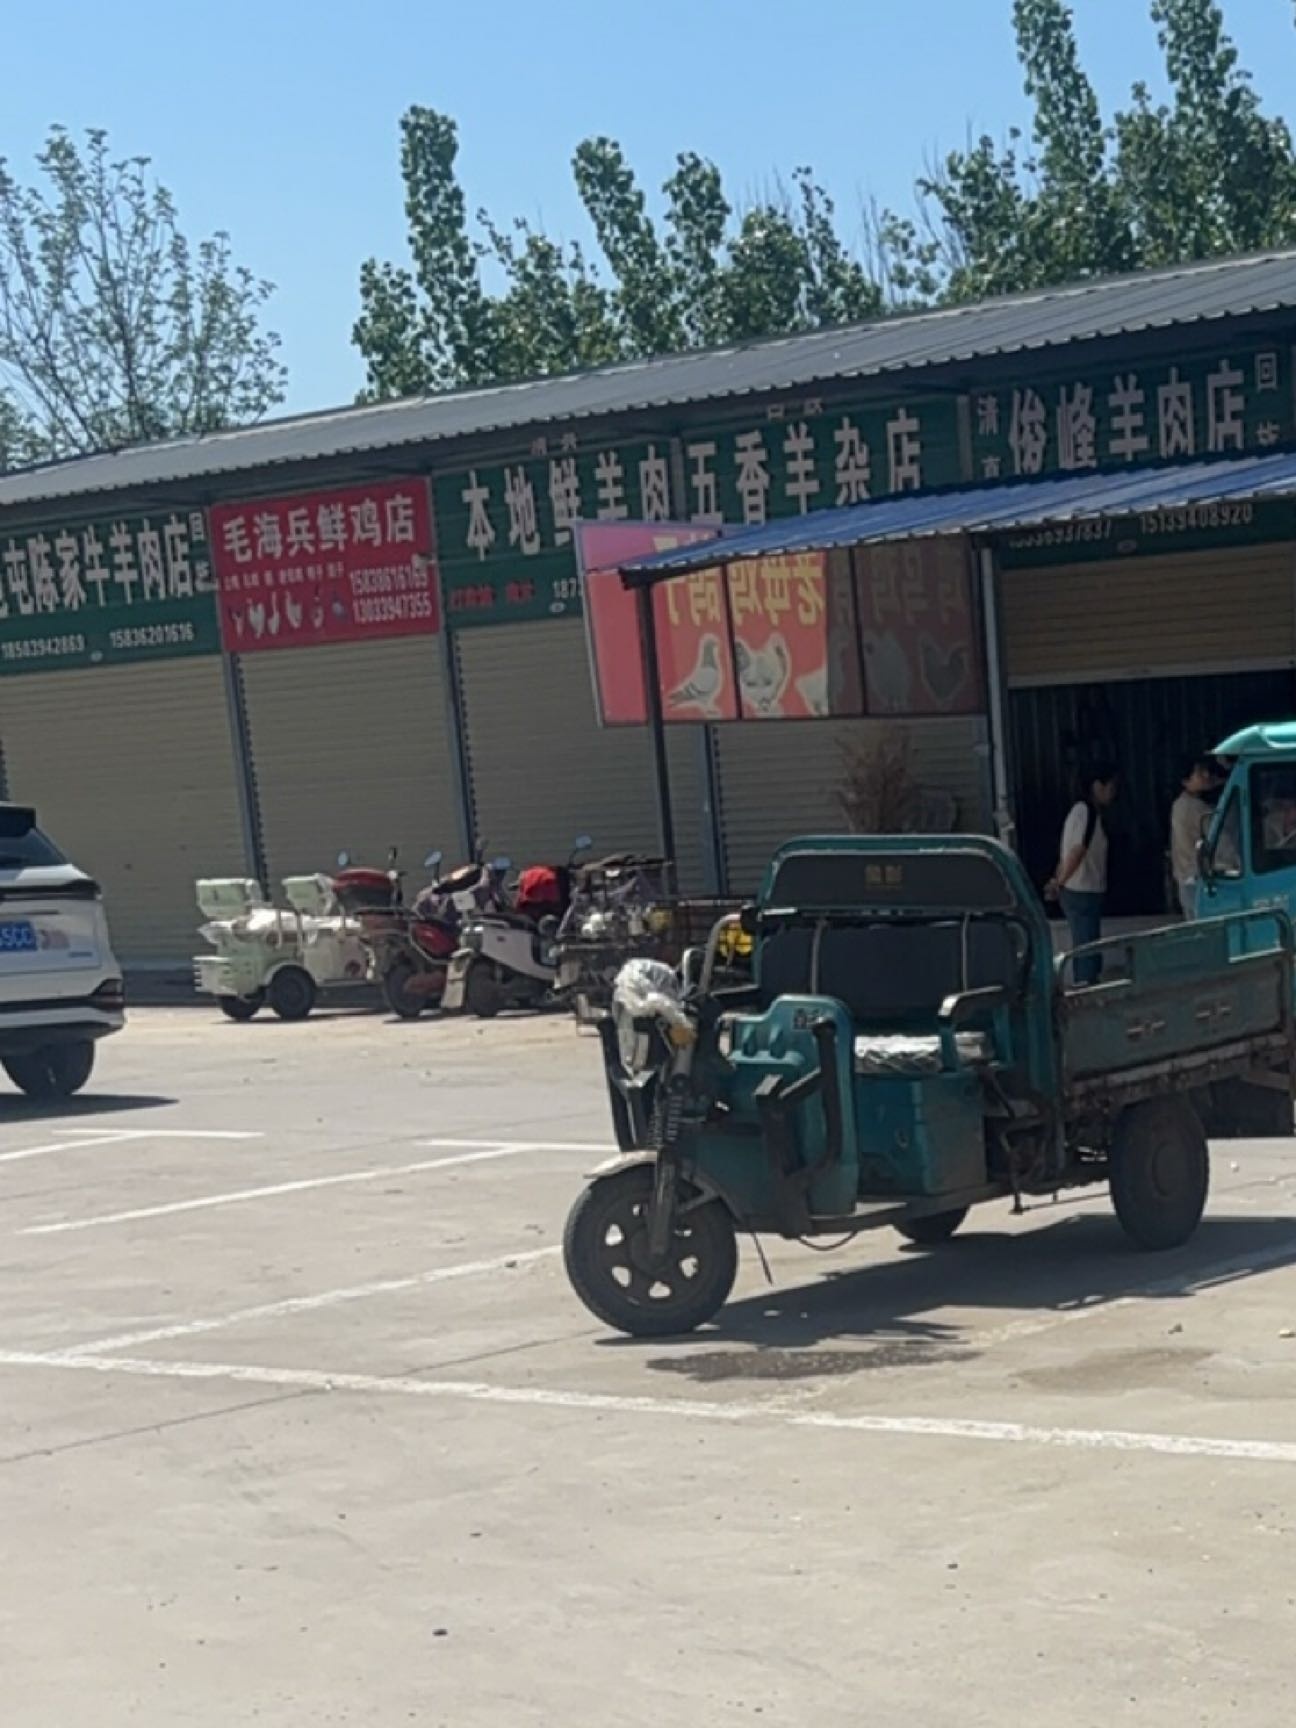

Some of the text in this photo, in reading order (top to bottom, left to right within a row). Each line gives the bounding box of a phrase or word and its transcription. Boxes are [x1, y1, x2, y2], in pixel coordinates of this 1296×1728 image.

[0, 512, 191, 618] 屯陈家牛羊肉店
[222, 491, 415, 563] 毛海兵鲜鸡店
